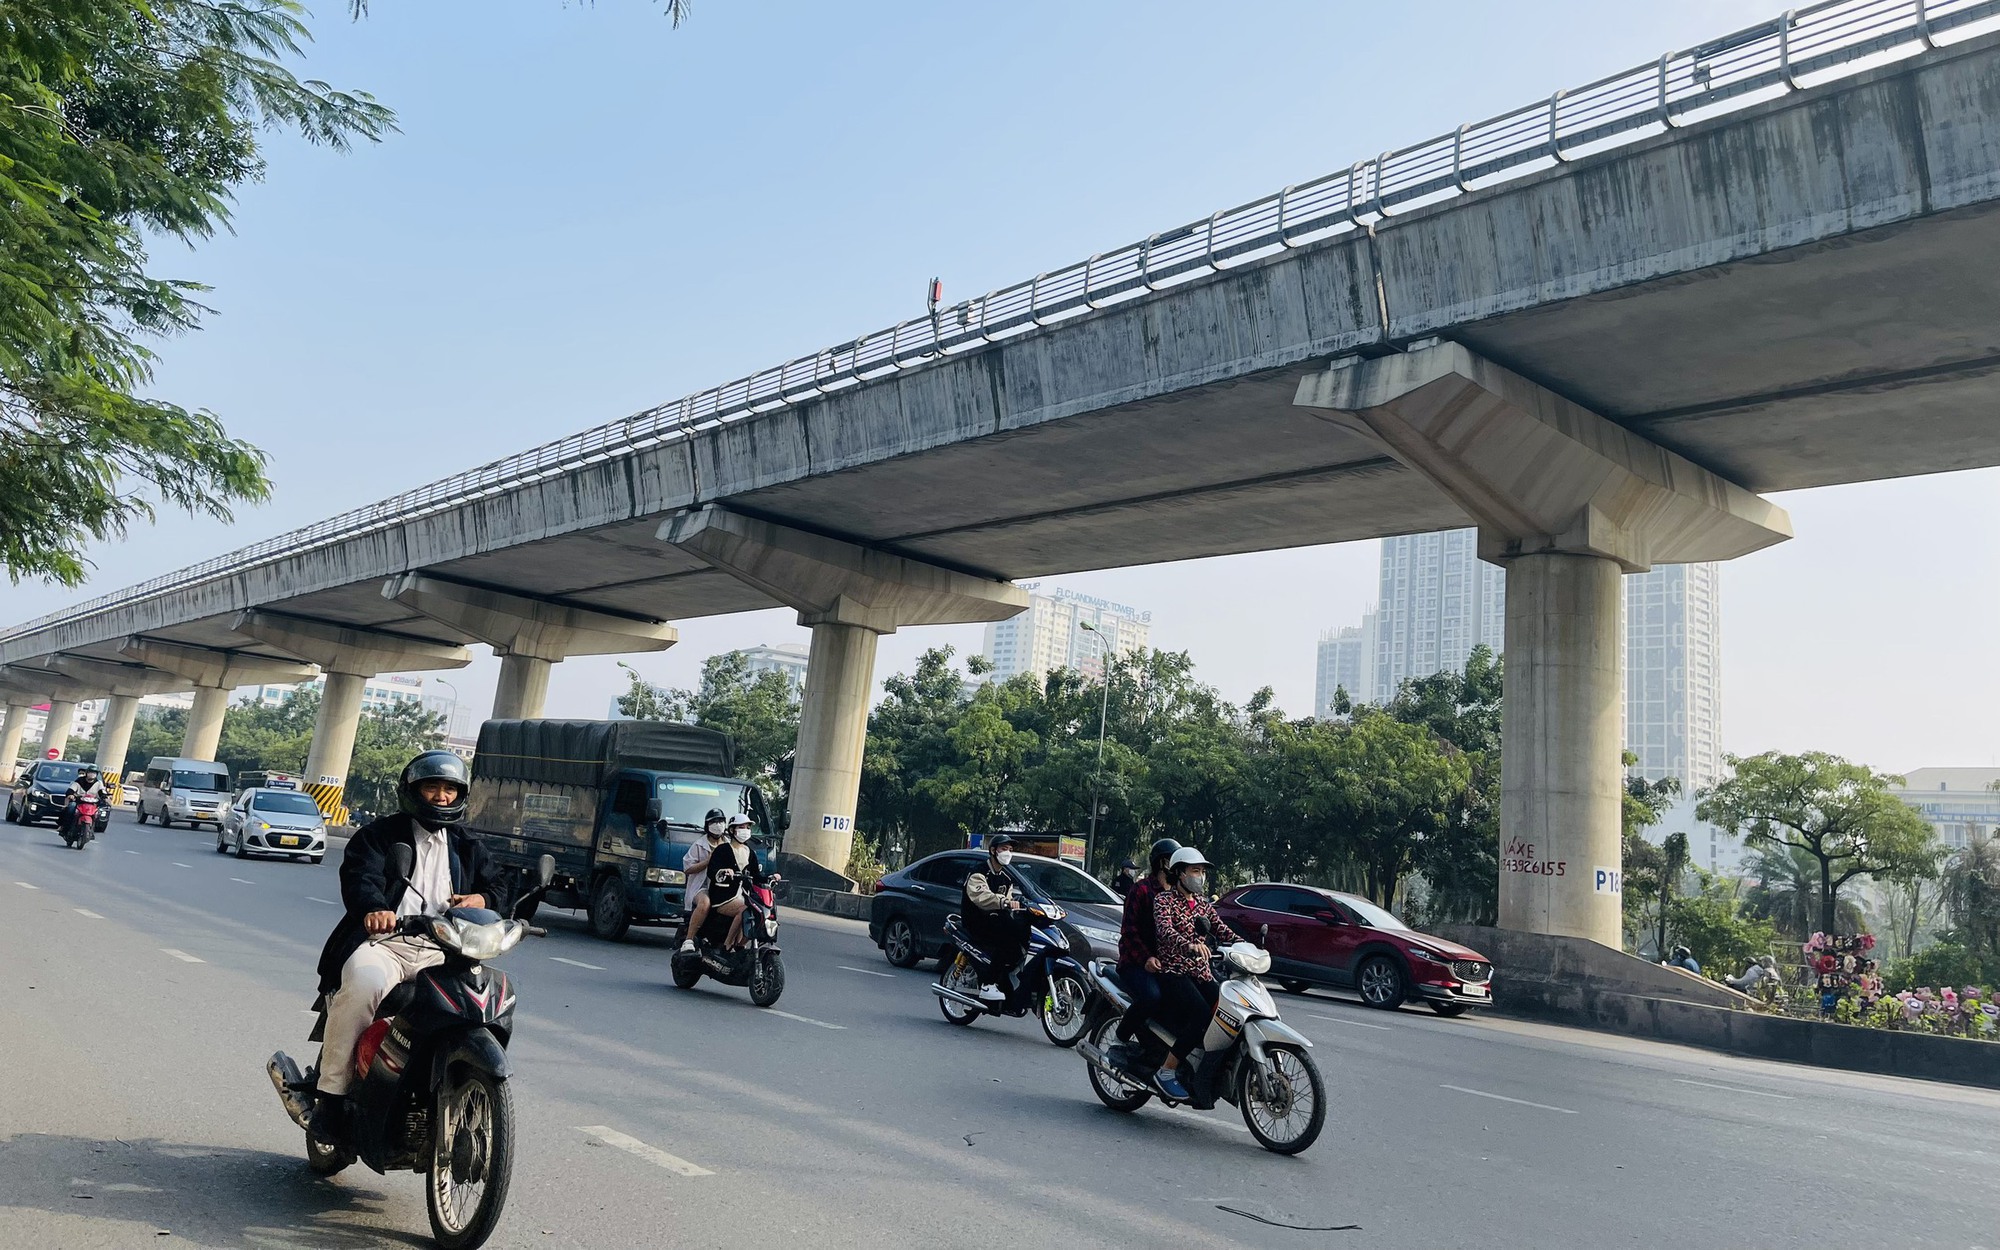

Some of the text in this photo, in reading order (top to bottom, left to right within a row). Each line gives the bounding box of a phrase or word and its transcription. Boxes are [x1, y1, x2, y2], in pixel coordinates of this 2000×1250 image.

[1056, 587, 1135, 616] FLC LANDMARK TOWER
[320, 775, 340, 785] P189
[822, 815, 850, 831] P187
[1596, 870, 1621, 893] P18
[1219, 1011, 1237, 1028] YAMAHA
[391, 1028, 411, 1050] YAMAHA
